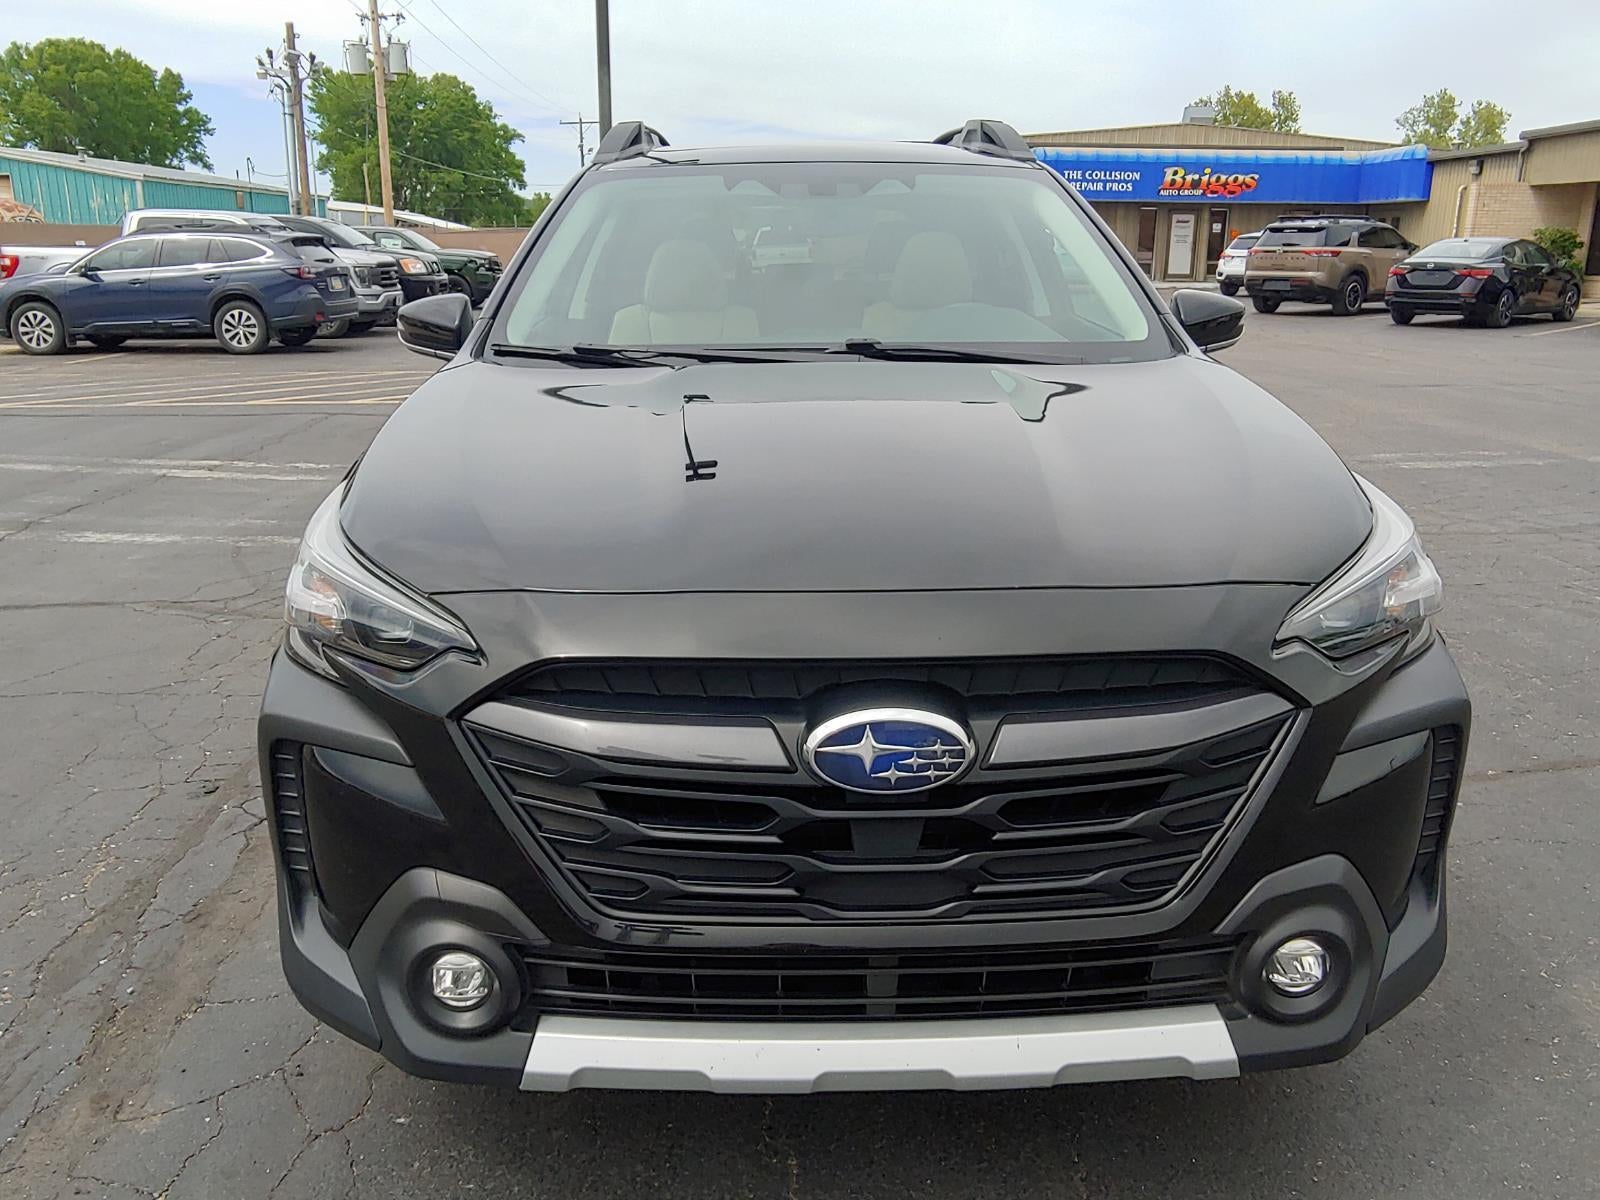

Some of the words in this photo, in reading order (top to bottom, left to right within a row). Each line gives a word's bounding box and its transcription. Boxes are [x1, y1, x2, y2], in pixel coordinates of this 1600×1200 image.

[1063, 170, 1083, 180] THE
[1085, 170, 1141, 181] COLLISION
[1106, 182, 1133, 192] PROS
[1159, 166, 1259, 198] Briggs
